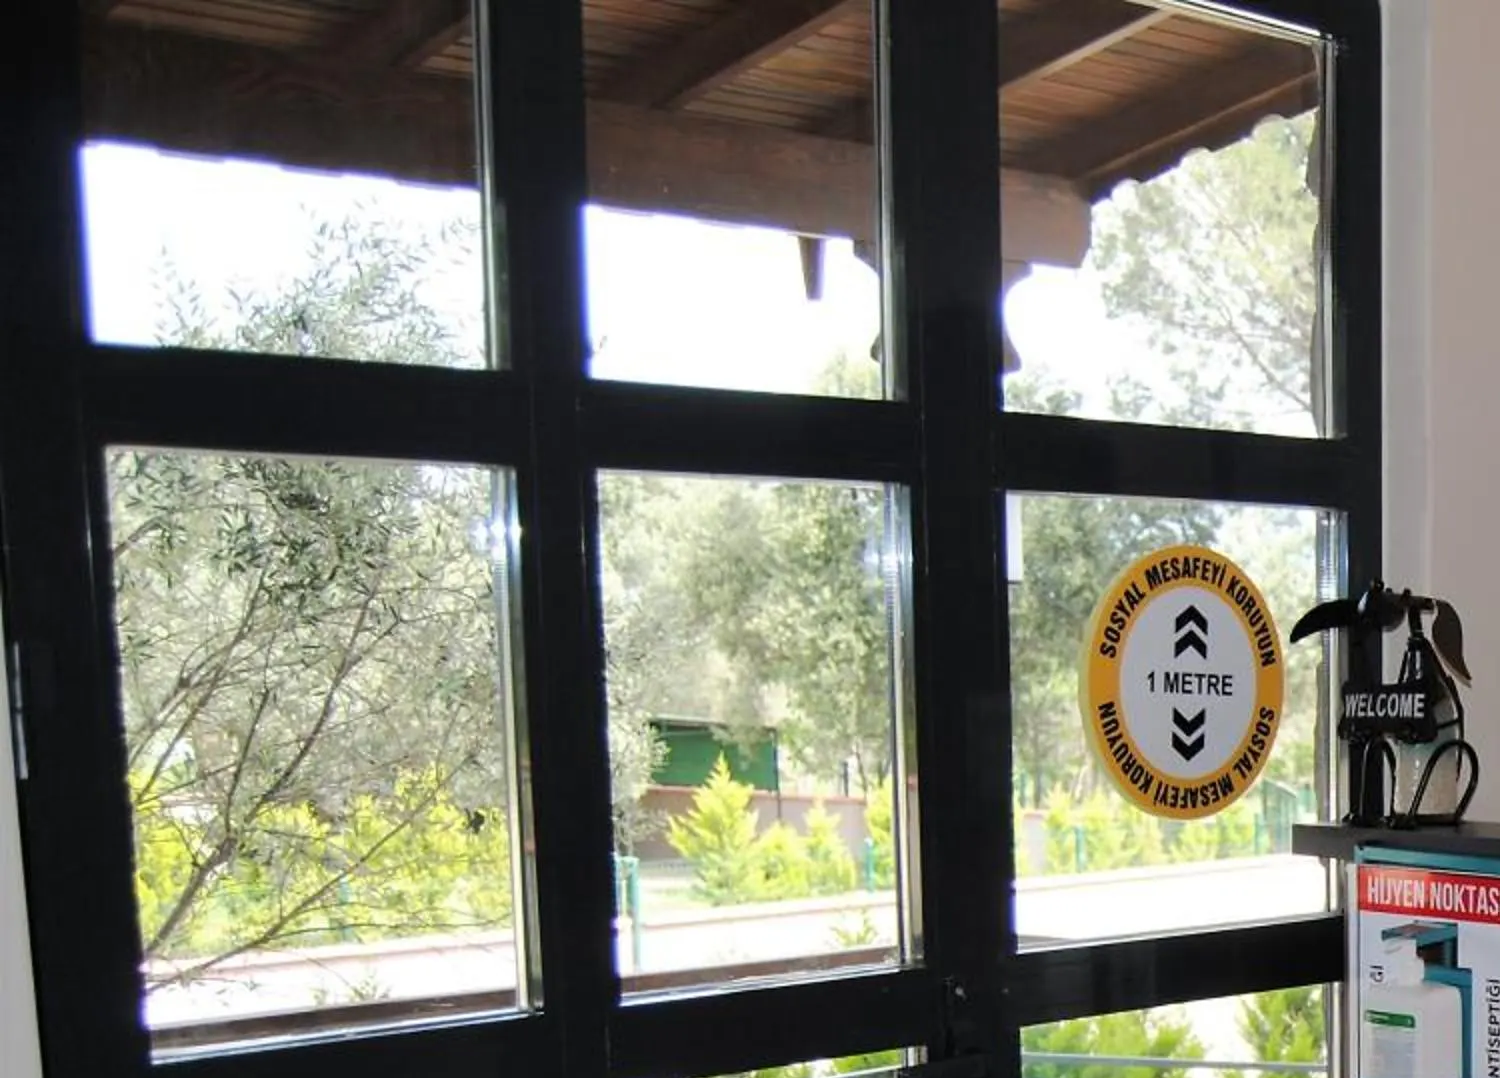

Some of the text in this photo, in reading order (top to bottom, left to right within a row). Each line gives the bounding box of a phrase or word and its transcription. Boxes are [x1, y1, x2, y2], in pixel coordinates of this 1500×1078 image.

[1100, 556, 1276, 667] SOSYAL MESAFEYİ KORUYUN
[1147, 671, 1234, 696] 1 METRE
[1345, 692, 1426, 718] WELCOME
[1098, 701, 1276, 809] SOSYAL MESAFEYİ KORUYUN
